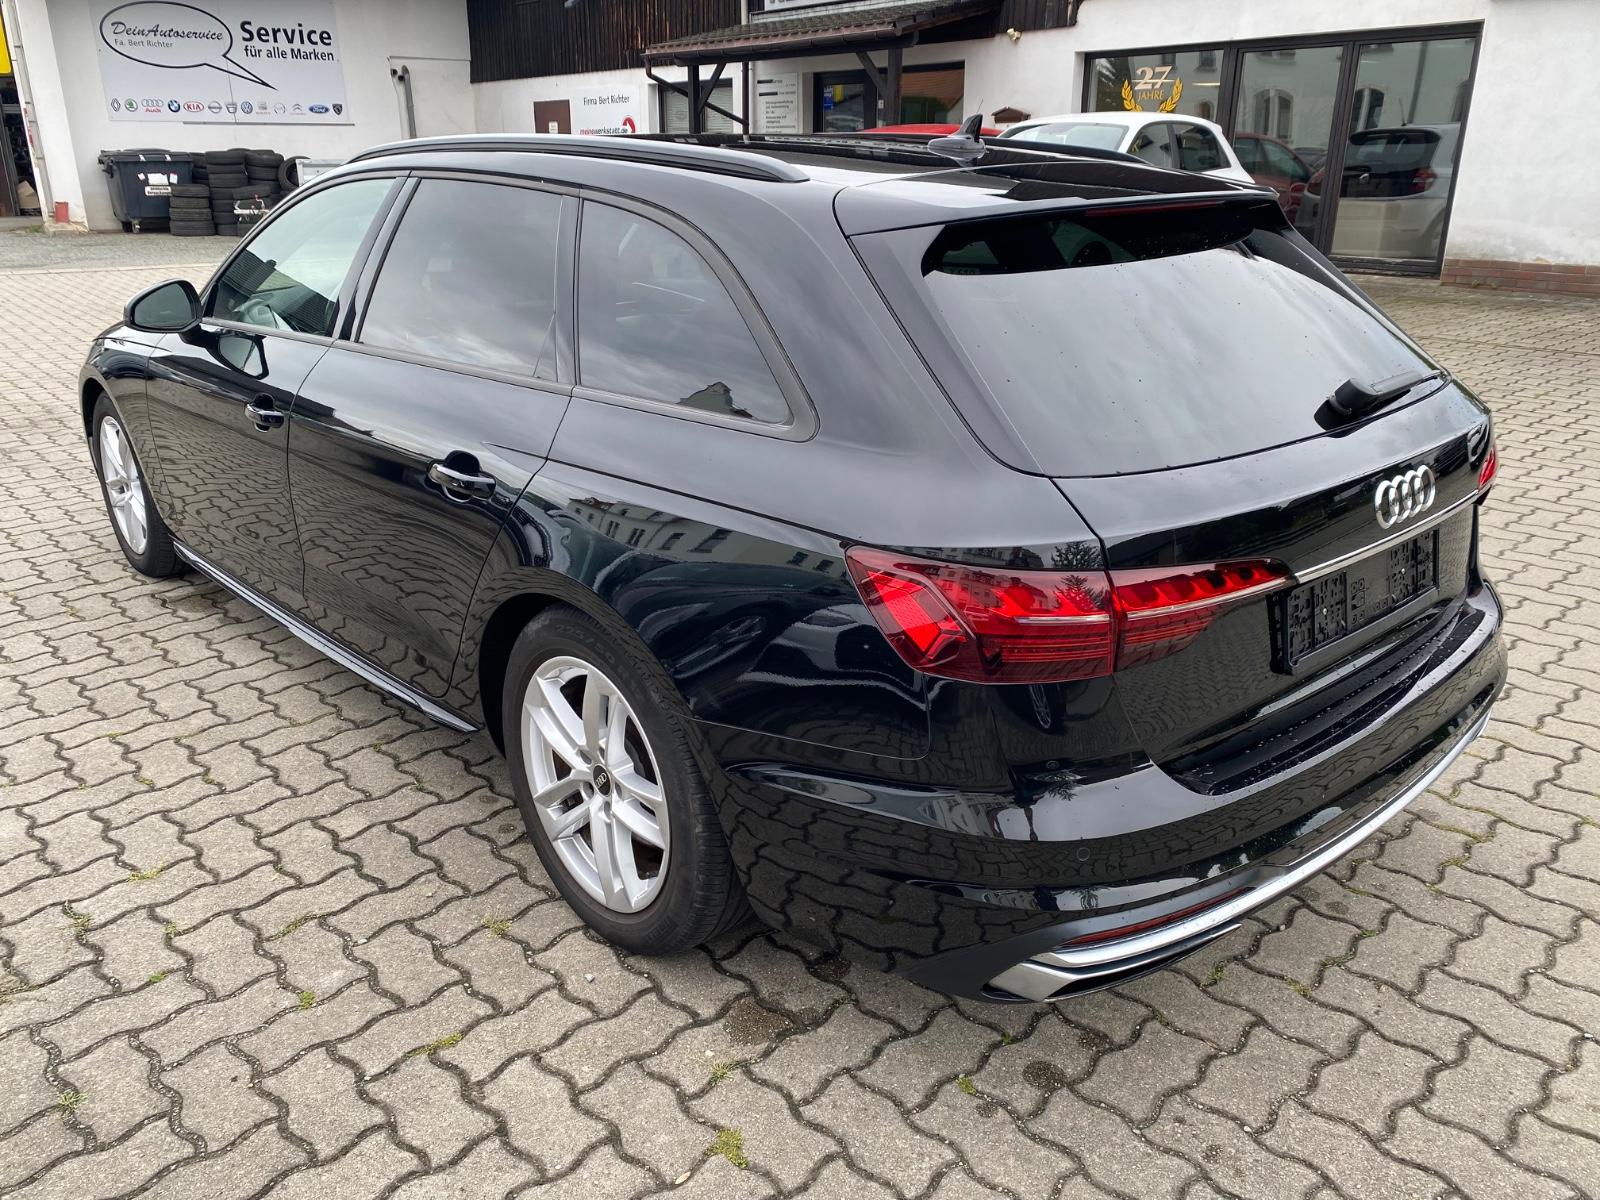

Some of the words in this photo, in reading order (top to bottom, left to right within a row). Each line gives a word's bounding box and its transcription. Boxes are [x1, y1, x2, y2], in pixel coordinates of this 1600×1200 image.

[111, 21, 223, 41] DeinAutoservice
[240, 20, 332, 46] Service
[128, 39, 144, 47] Bert
[146, 40, 173, 48] Richter
[244, 45, 262, 58] für
[266, 46, 287, 59] alle
[291, 47, 334, 61] Marken
[1135, 65, 1173, 90] 27
[583, 96, 598, 106] Firma
[598, 95, 610, 105] Bert
[610, 94, 630, 104] Richter
[1137, 90, 1164, 102] JAHRE
